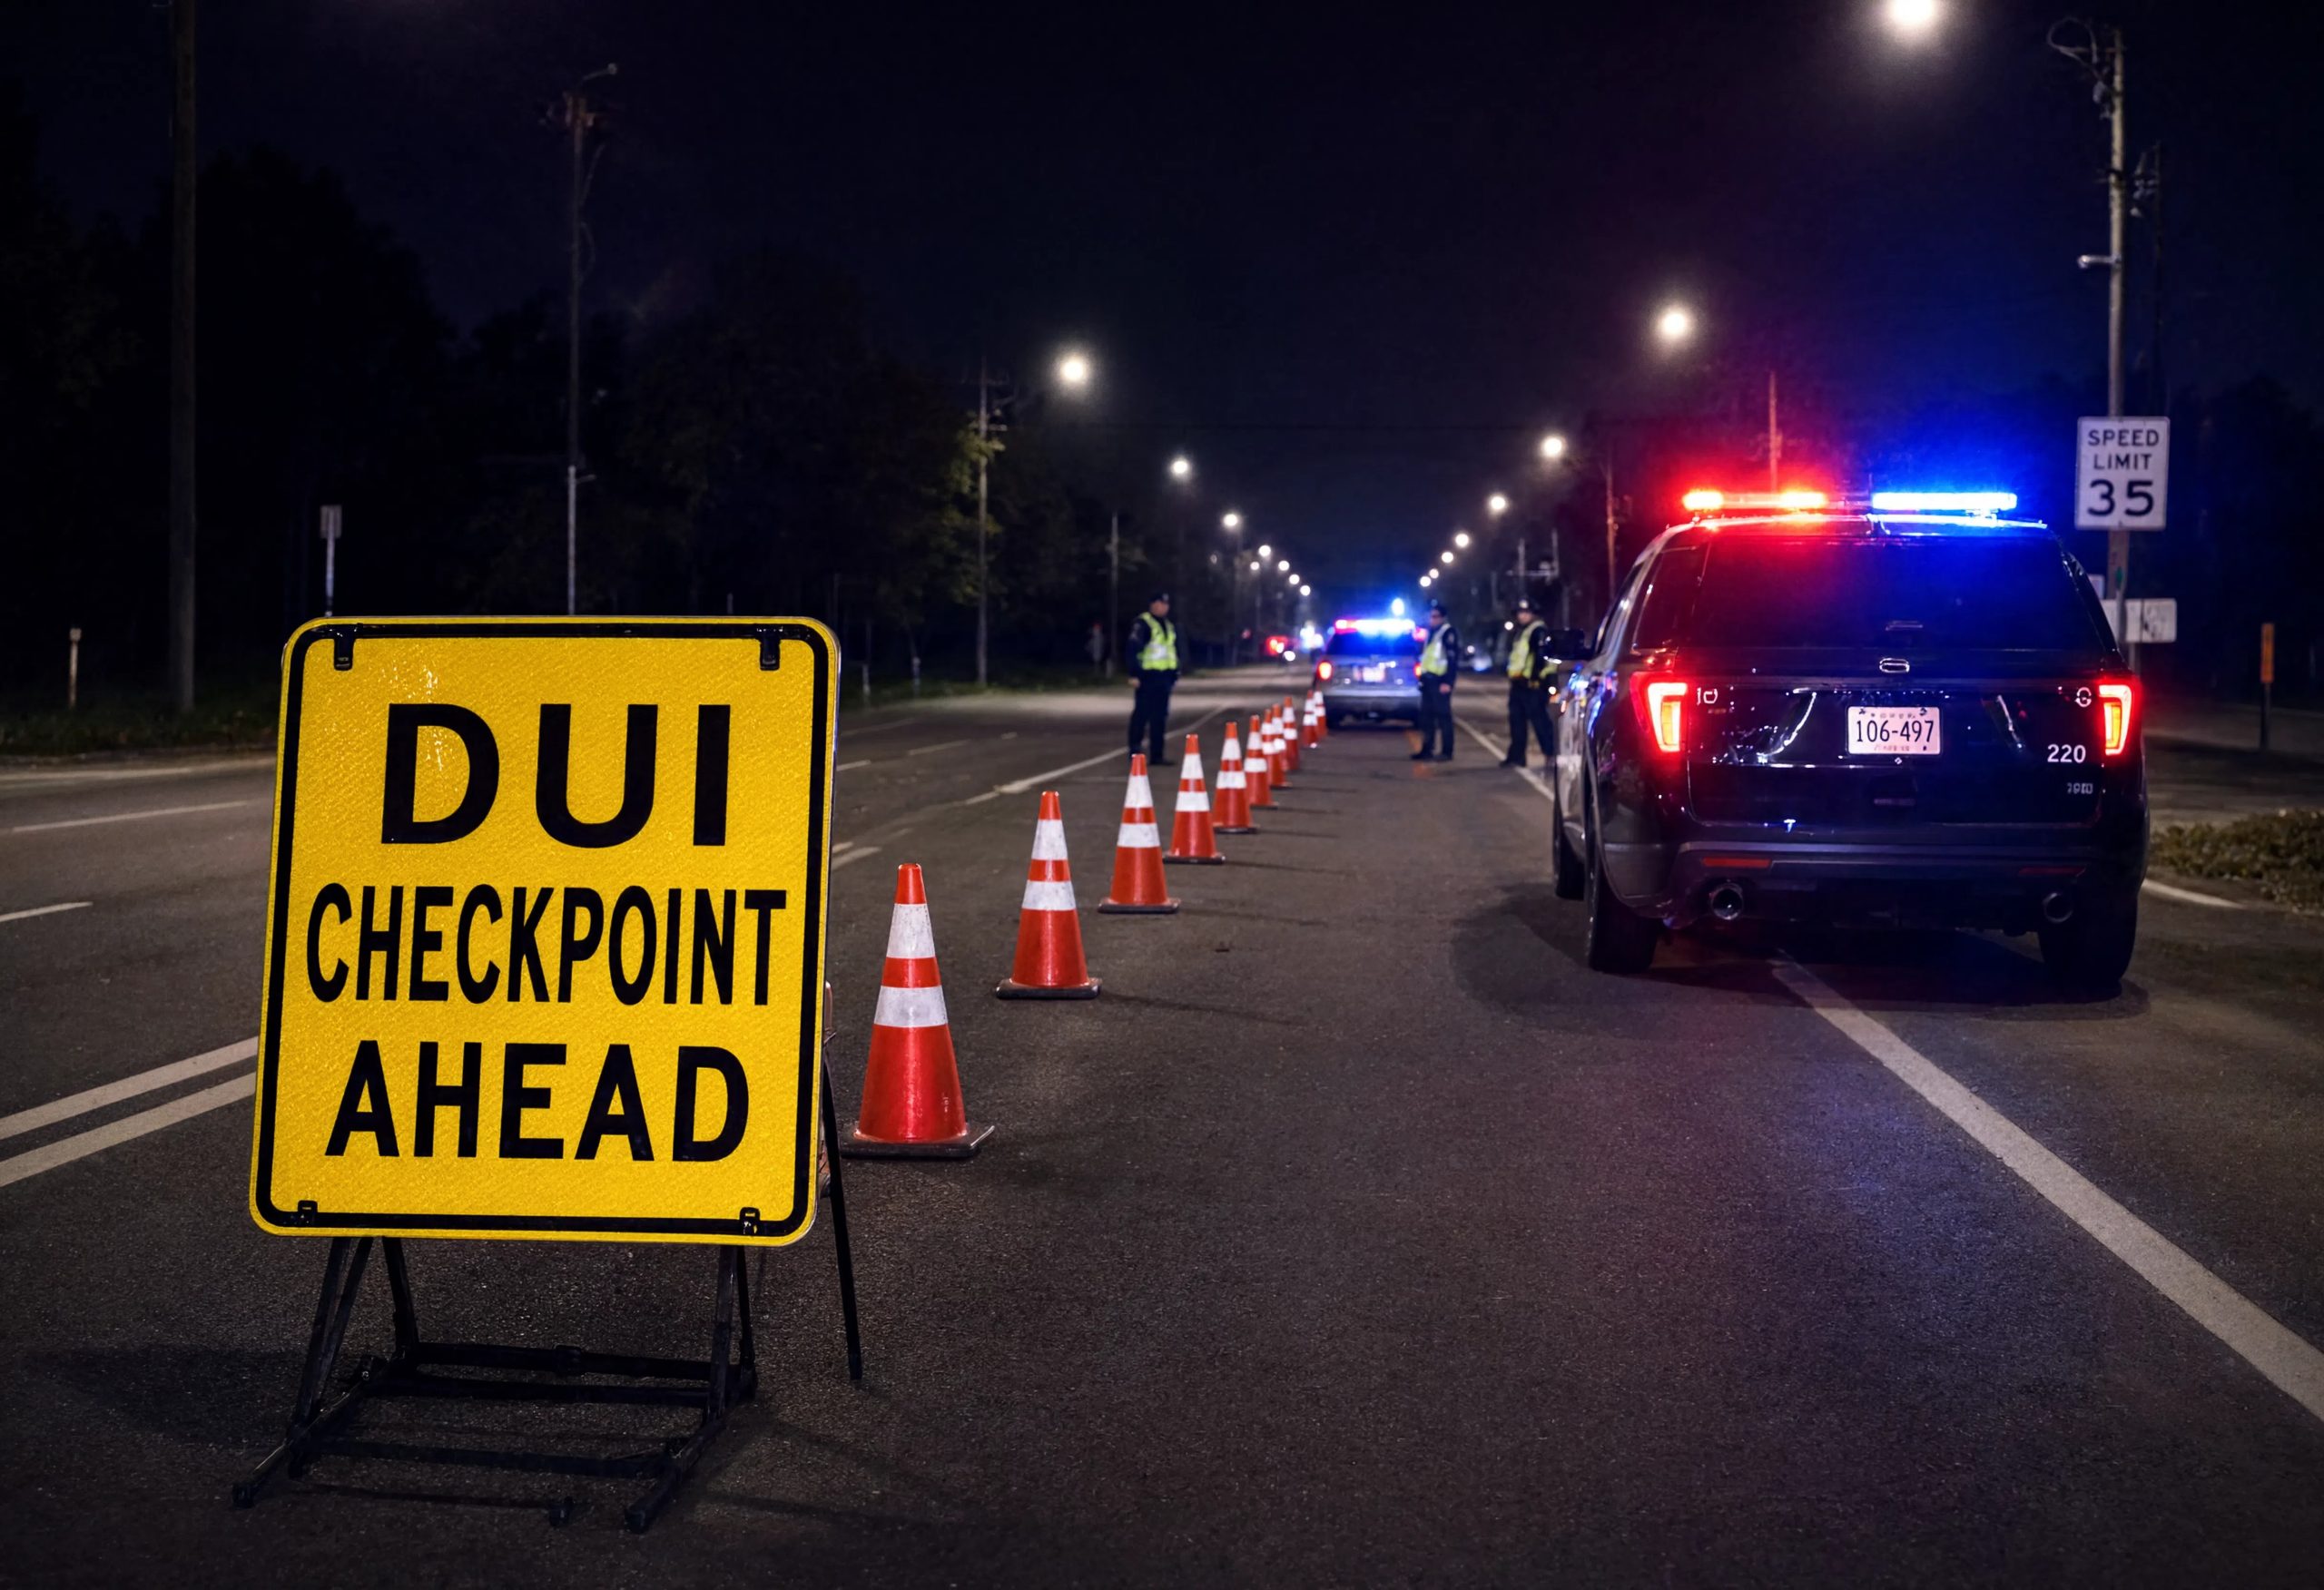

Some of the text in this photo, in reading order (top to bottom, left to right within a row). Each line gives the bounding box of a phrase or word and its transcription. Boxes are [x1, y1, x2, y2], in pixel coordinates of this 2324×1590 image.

[2088, 428, 2159, 447] SPEED
[2093, 453, 2152, 470] LIMIT
[2087, 479, 2154, 517] 35
[1856, 720, 1935, 742] 106-497
[2047, 744, 2086, 763] 220
[381, 702, 732, 849] DUI
[306, 882, 787, 1006] CHECKPOINT
[324, 1039, 750, 1163] AHEAD
